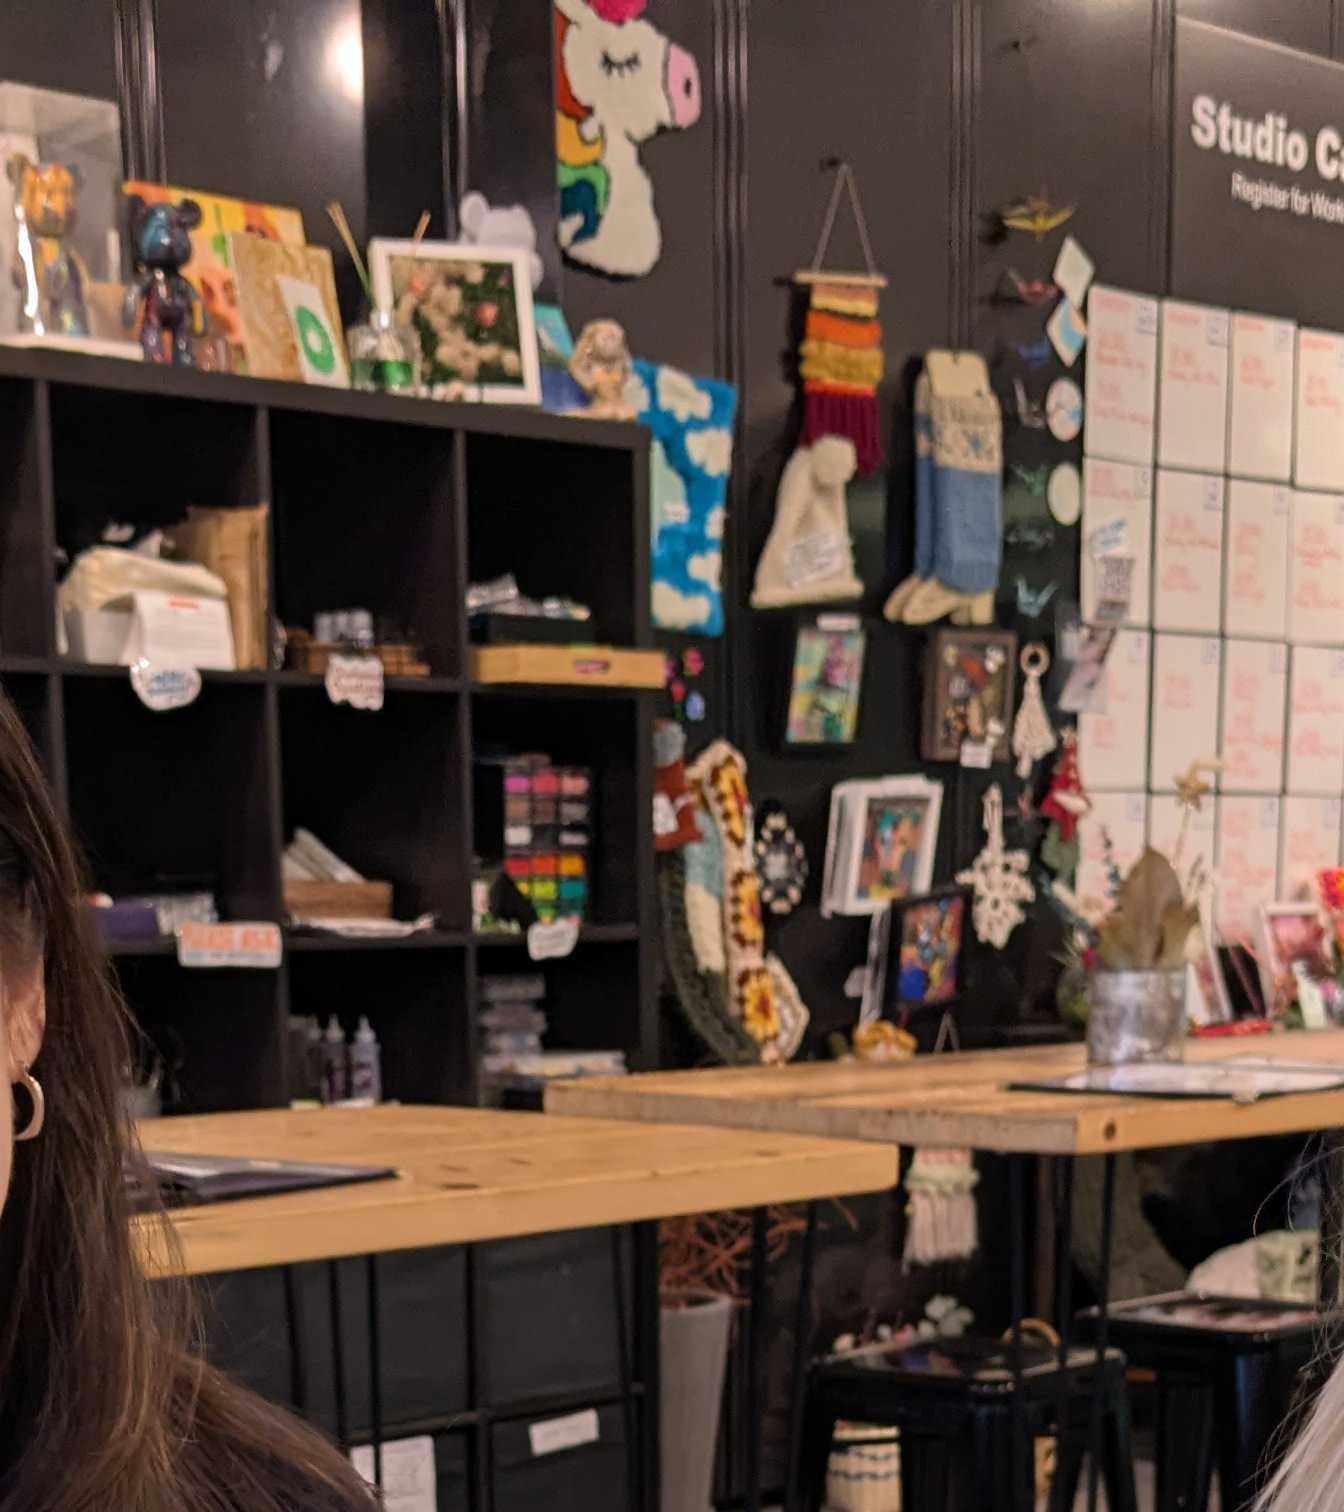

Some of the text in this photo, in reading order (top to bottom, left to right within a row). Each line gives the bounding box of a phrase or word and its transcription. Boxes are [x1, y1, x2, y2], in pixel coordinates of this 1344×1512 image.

[1192, 94, 1308, 172] Studio
[1231, 171, 1289, 210] Register
[1290, 186, 1311, 215] for
